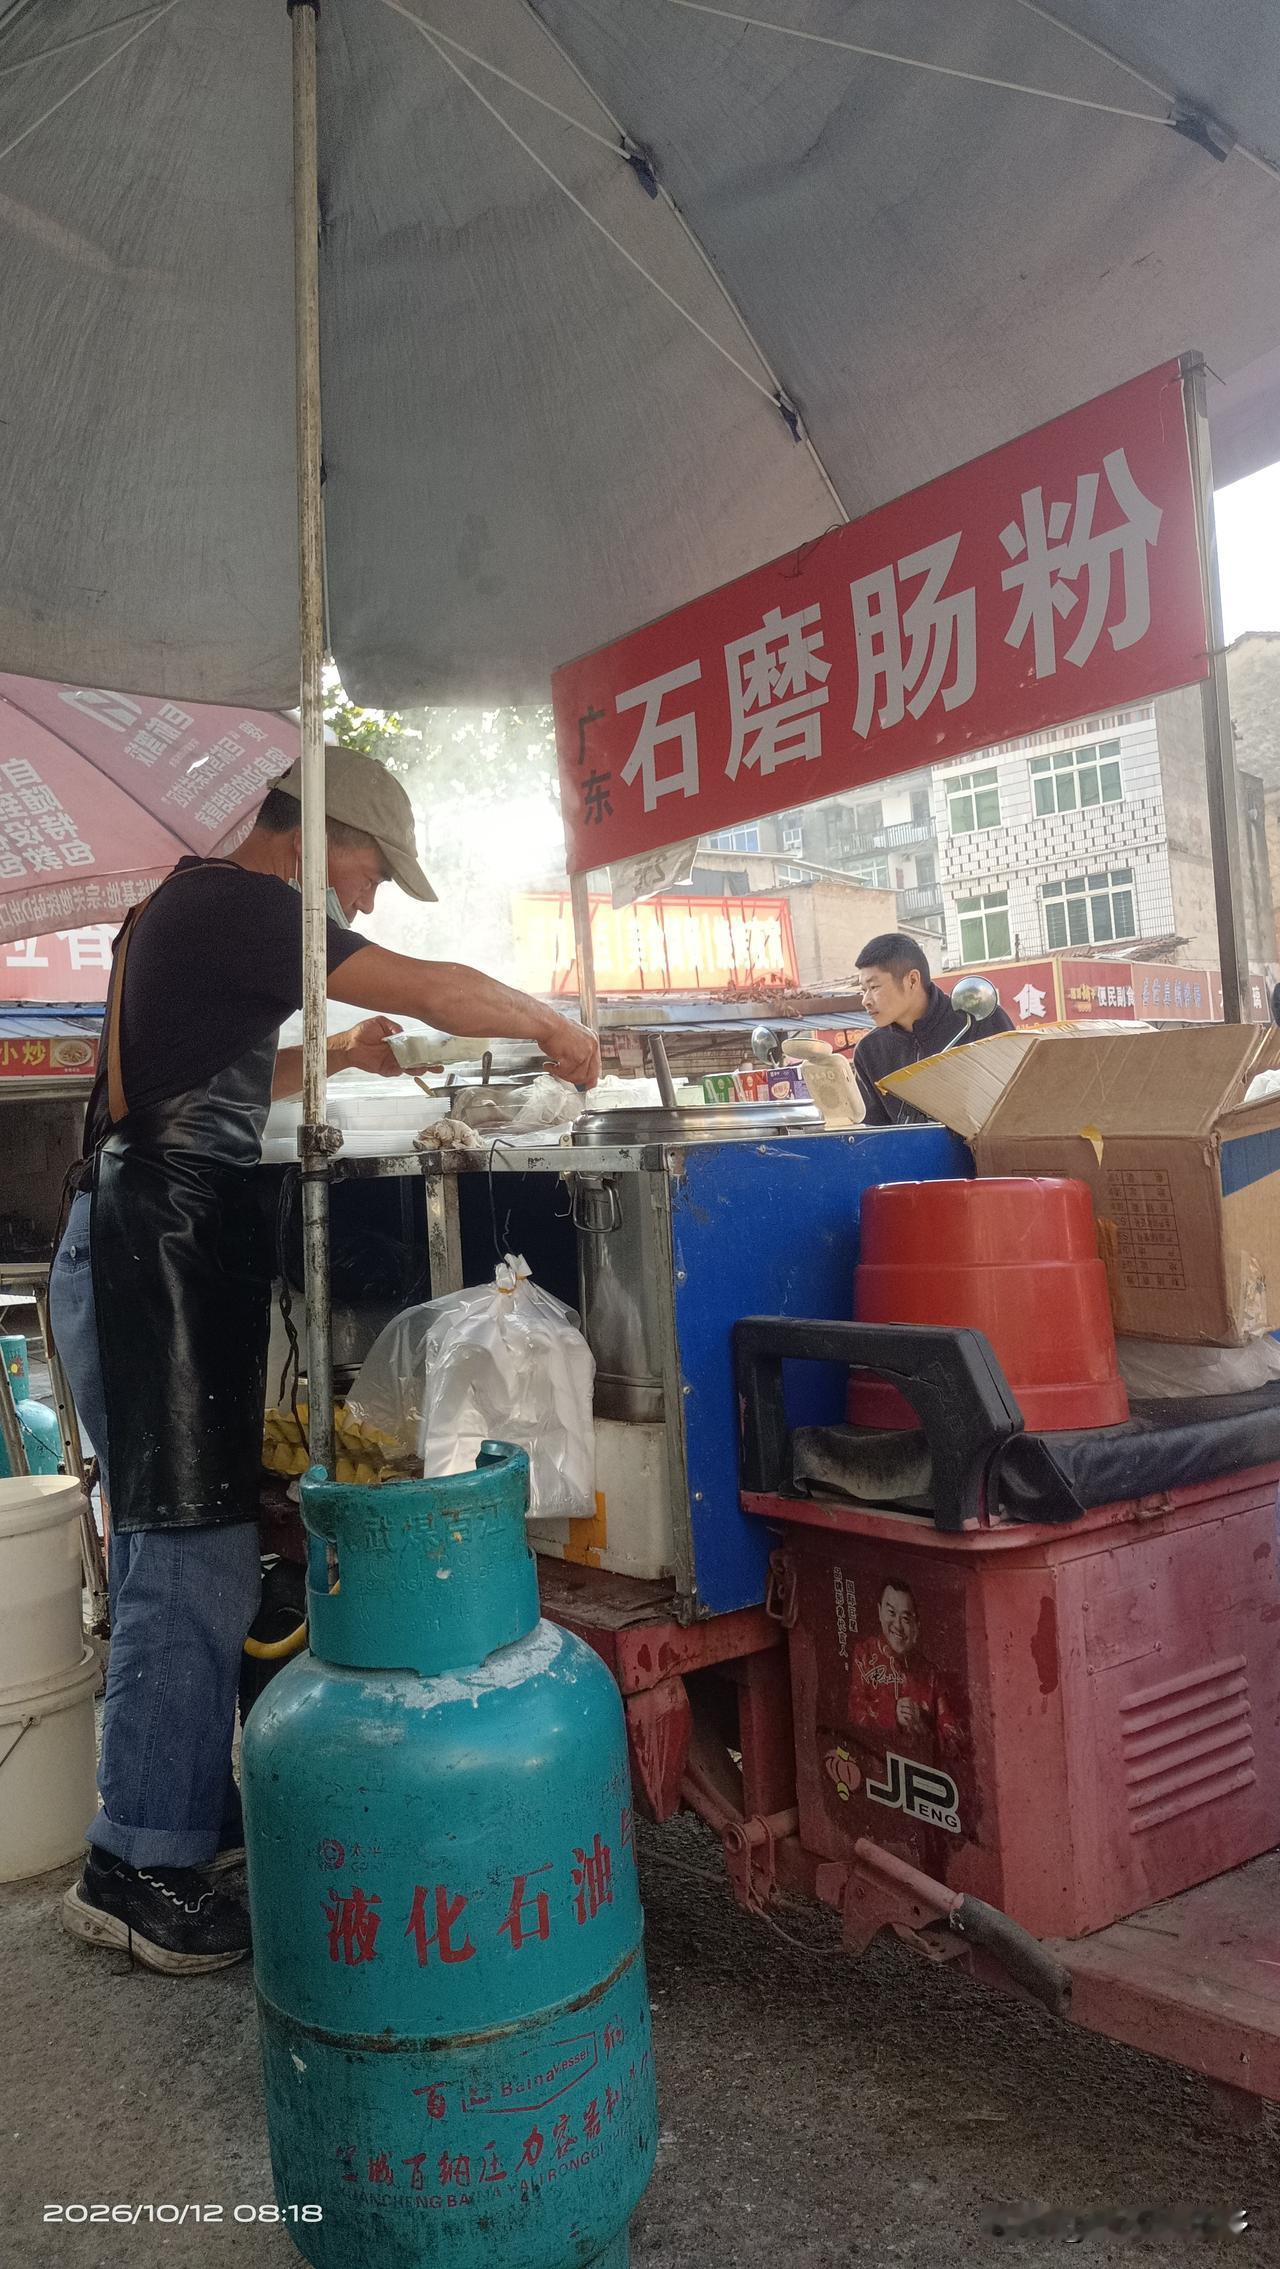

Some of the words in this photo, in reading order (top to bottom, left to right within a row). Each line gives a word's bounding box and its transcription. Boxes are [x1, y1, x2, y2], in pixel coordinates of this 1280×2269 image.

[614, 447, 1164, 814] 石磨肠粉
[577, 704, 614, 825] 广东
[1096, 985, 1136, 1008] 便民副食
[0, 1039, 47, 1067] 小炒
